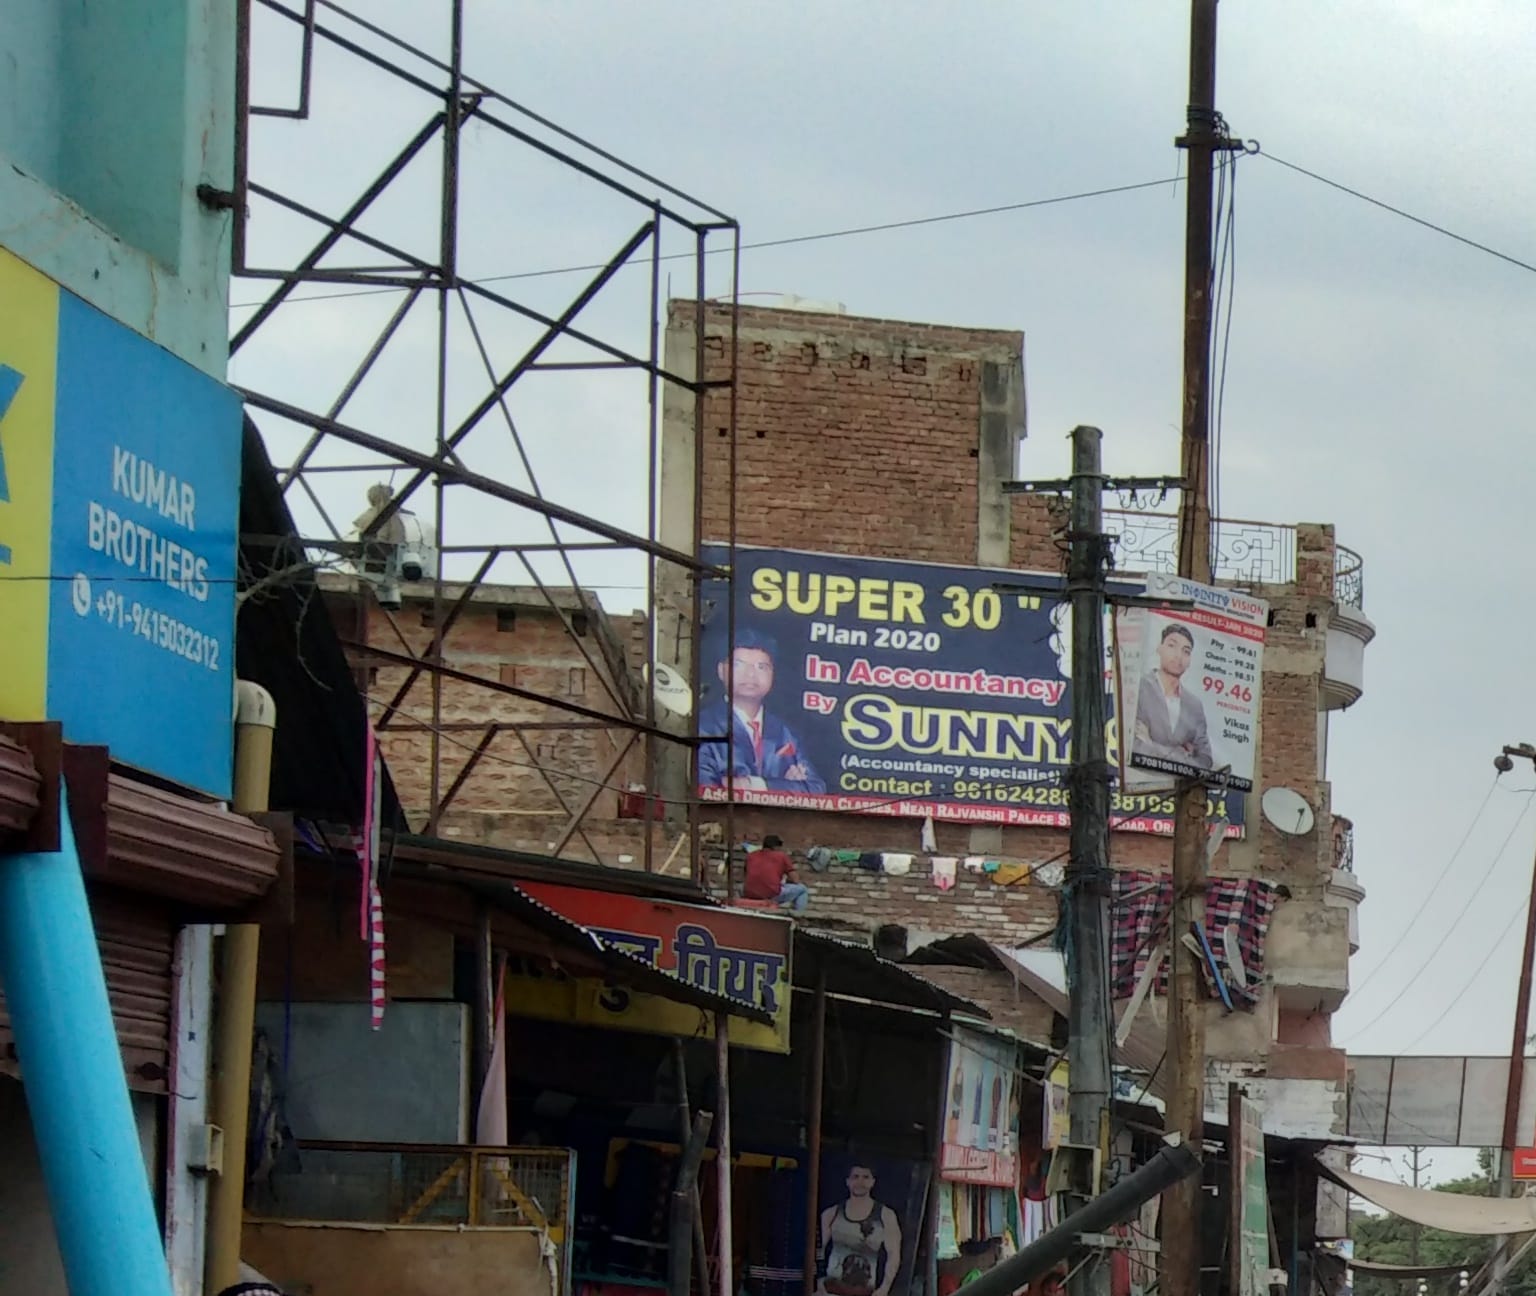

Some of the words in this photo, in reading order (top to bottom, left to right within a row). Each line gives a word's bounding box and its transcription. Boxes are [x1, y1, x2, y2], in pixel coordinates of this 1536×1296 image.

[113, 445, 195, 531] KUMAR
[88, 502, 208, 601] BROTHERS
[750, 568, 925, 624] SUPER
[942, 586, 1002, 630] 30
[1231, 598, 1264, 616] VISION
[810, 623, 867, 646] Plan
[874, 628, 940, 651] 2020
[806, 654, 839, 683] In
[847, 657, 1066, 704] Accountancy
[1203, 676, 1252, 702] 99.46
[803, 692, 836, 713] By
[1224, 716, 1249, 731] Vikas
[1222, 729, 1249, 744] Singh
[841, 755, 964, 777] (Accountancy
[840, 773, 932, 796] Contact
